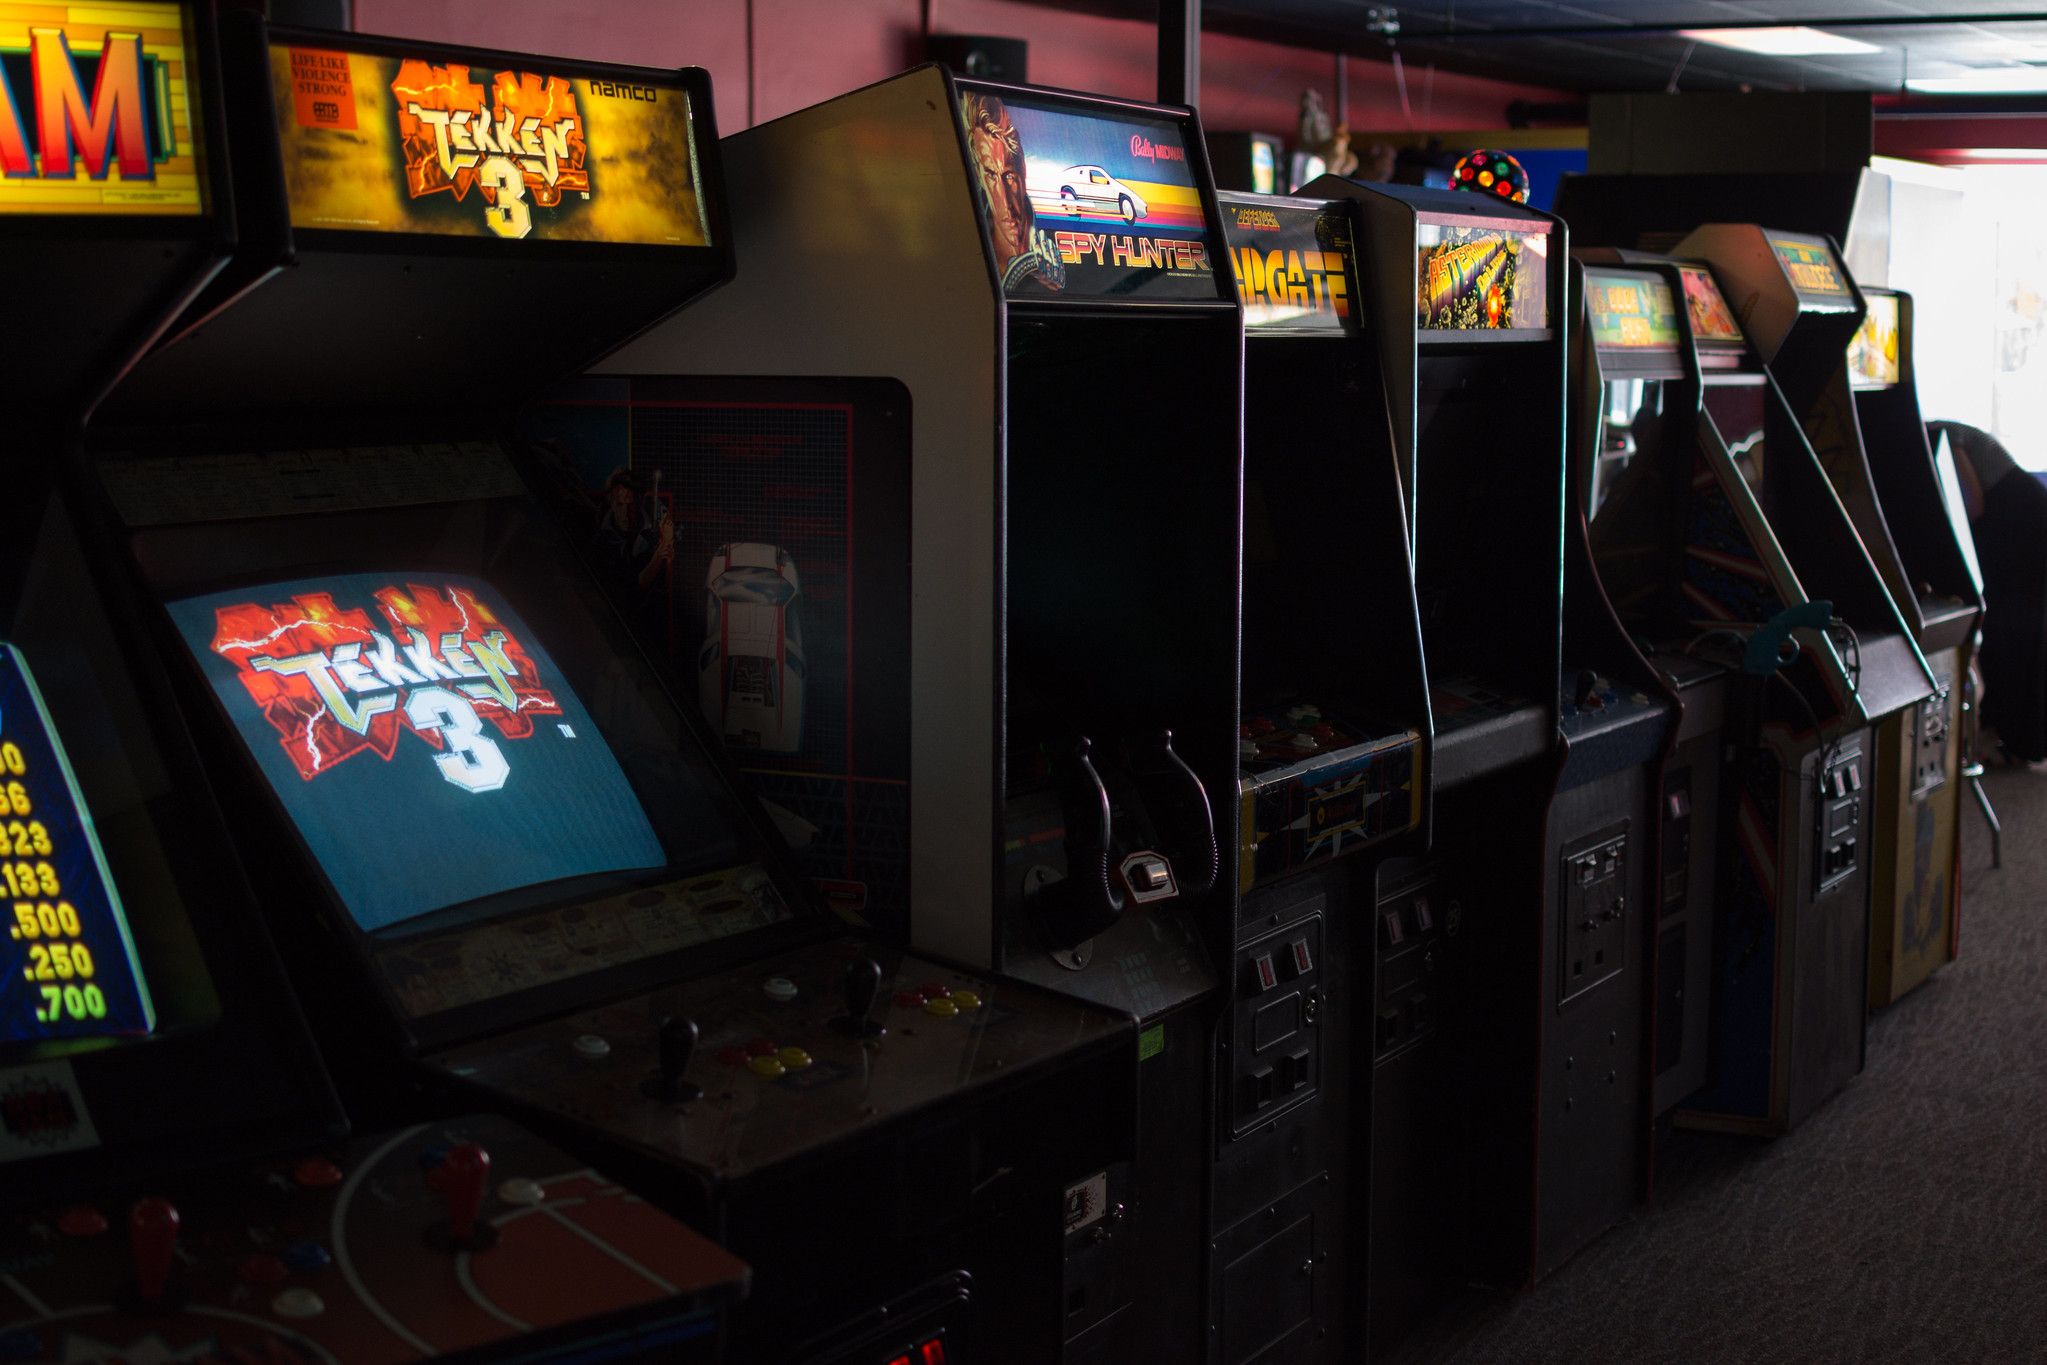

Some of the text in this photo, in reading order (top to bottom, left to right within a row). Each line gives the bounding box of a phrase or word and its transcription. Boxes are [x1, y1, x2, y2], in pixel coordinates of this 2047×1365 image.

[292, 53, 346, 69] LIFE-LIKE
[292, 66, 351, 84] VIOLENCE
[299, 82, 346, 96] STRONG
[590, 81, 657, 102] namco
[408, 103, 575, 187] TEKKEN
[1130, 135, 1184, 165] Bally MIDWAY
[479, 155, 532, 239] 3
[1055, 231, 1212, 271] SPY HUNTER
[248, 629, 520, 736] TEKKEN
[0, 741, 26, 776] 0
[404, 686, 511, 794] 3
[10, 901, 81, 940] .500
[24, 942, 94, 982] .250
[36, 982, 107, 1023] .700
